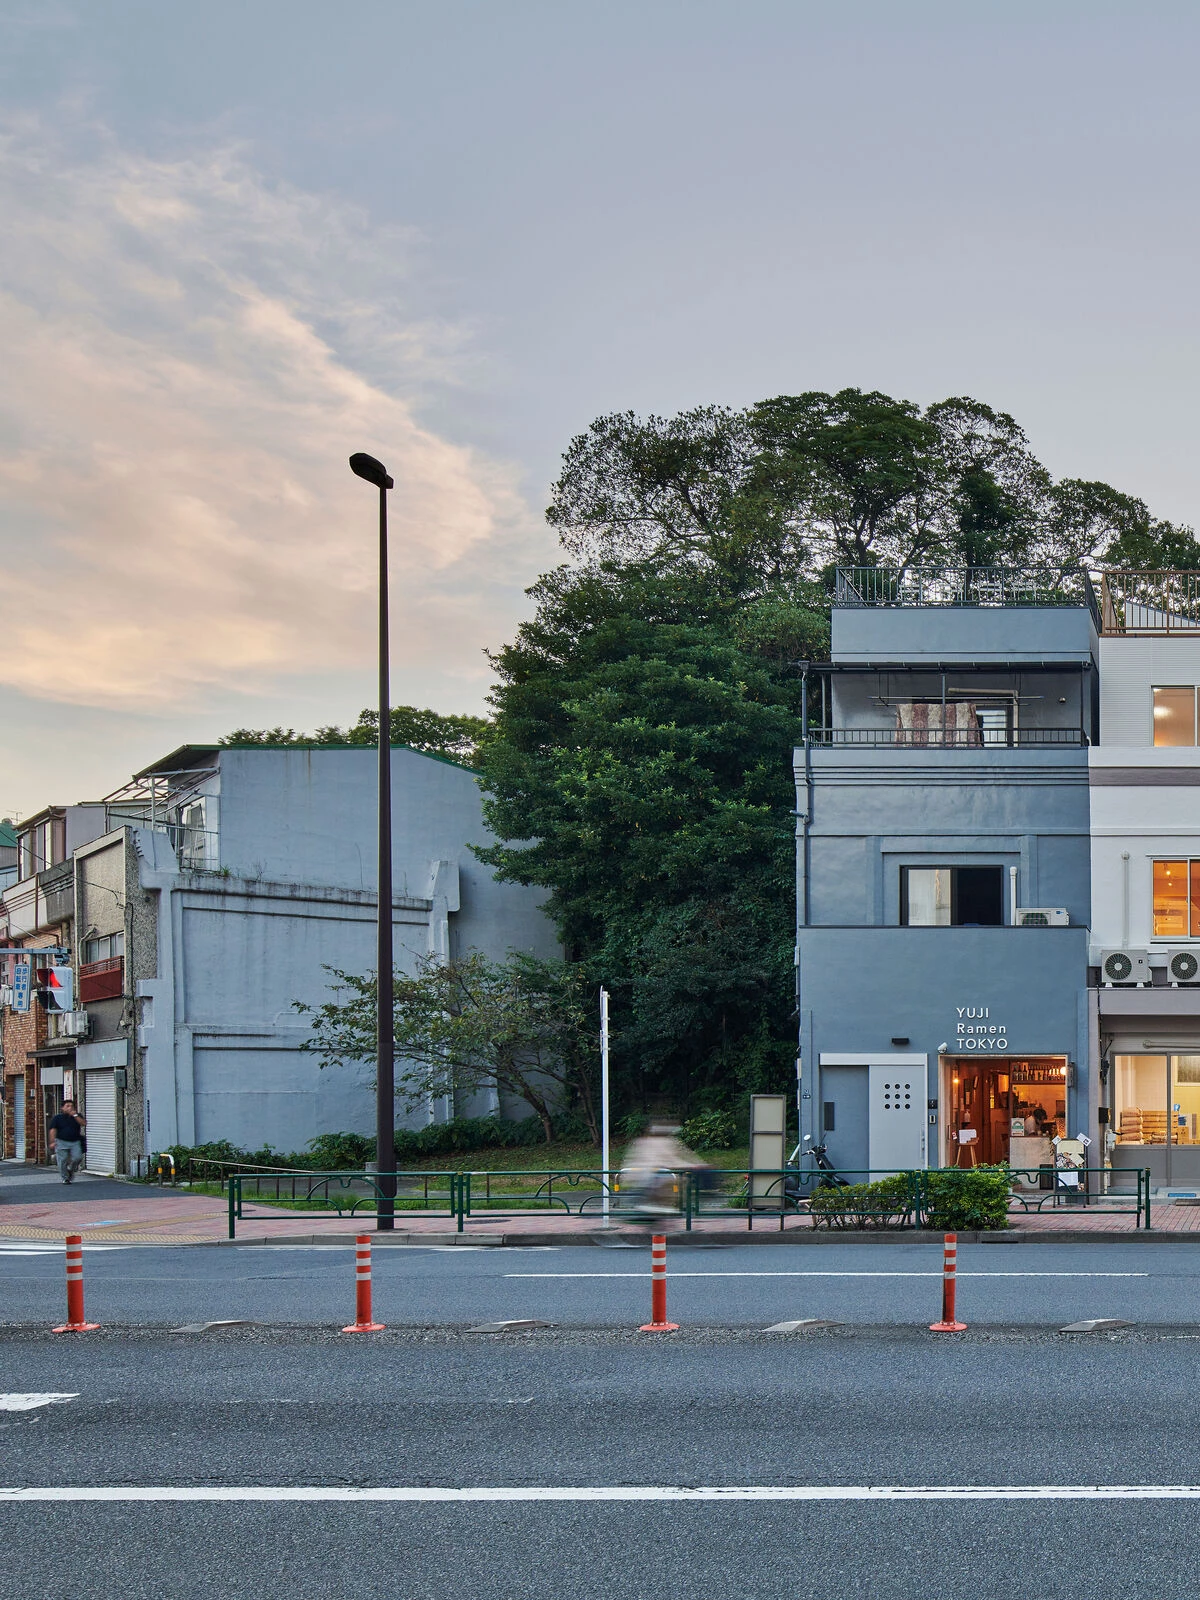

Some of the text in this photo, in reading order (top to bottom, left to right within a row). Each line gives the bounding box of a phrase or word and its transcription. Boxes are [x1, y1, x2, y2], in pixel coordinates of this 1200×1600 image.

[956, 1007, 989, 1018] YUJI
[957, 1023, 1006, 1034] Ramen
[956, 1038, 1008, 1049] TOKYO
